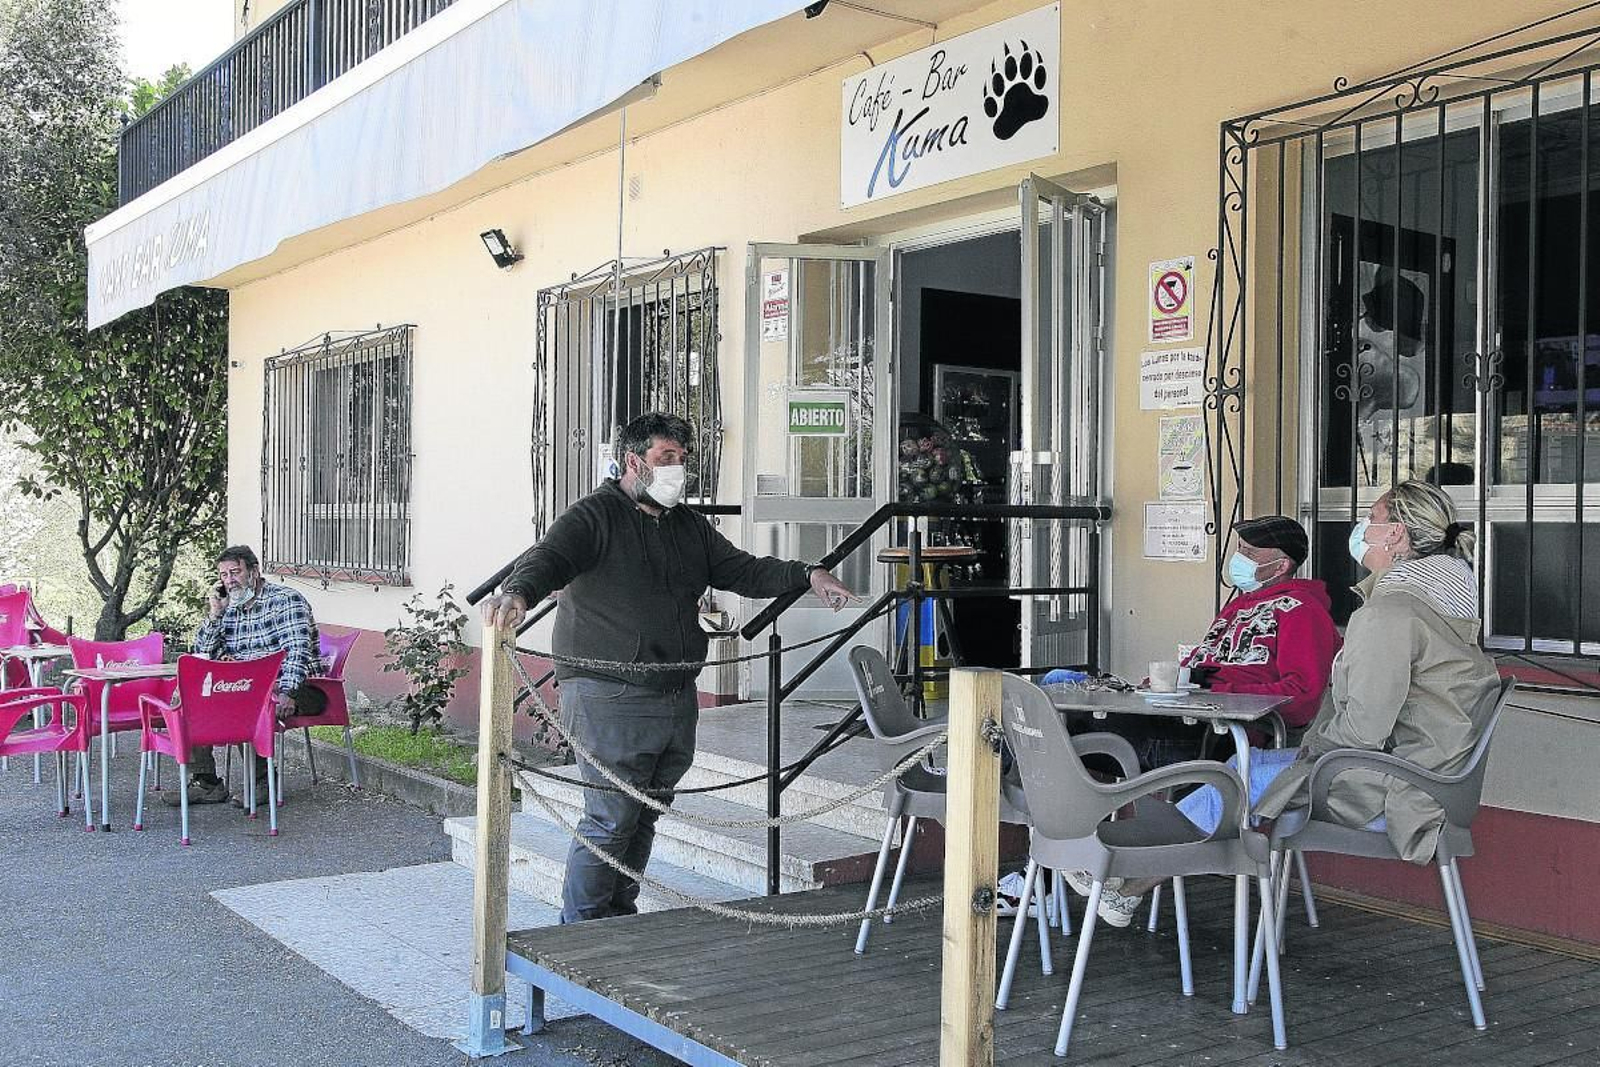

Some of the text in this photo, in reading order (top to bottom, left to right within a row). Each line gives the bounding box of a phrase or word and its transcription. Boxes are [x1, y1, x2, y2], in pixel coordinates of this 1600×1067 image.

[848, 71, 895, 131] Café
[922, 50, 968, 101] Bar
[868, 107, 969, 197] Kuma
[791, 408, 845, 426] ABIERTO
[213, 679, 253, 693] Coca-Cola
